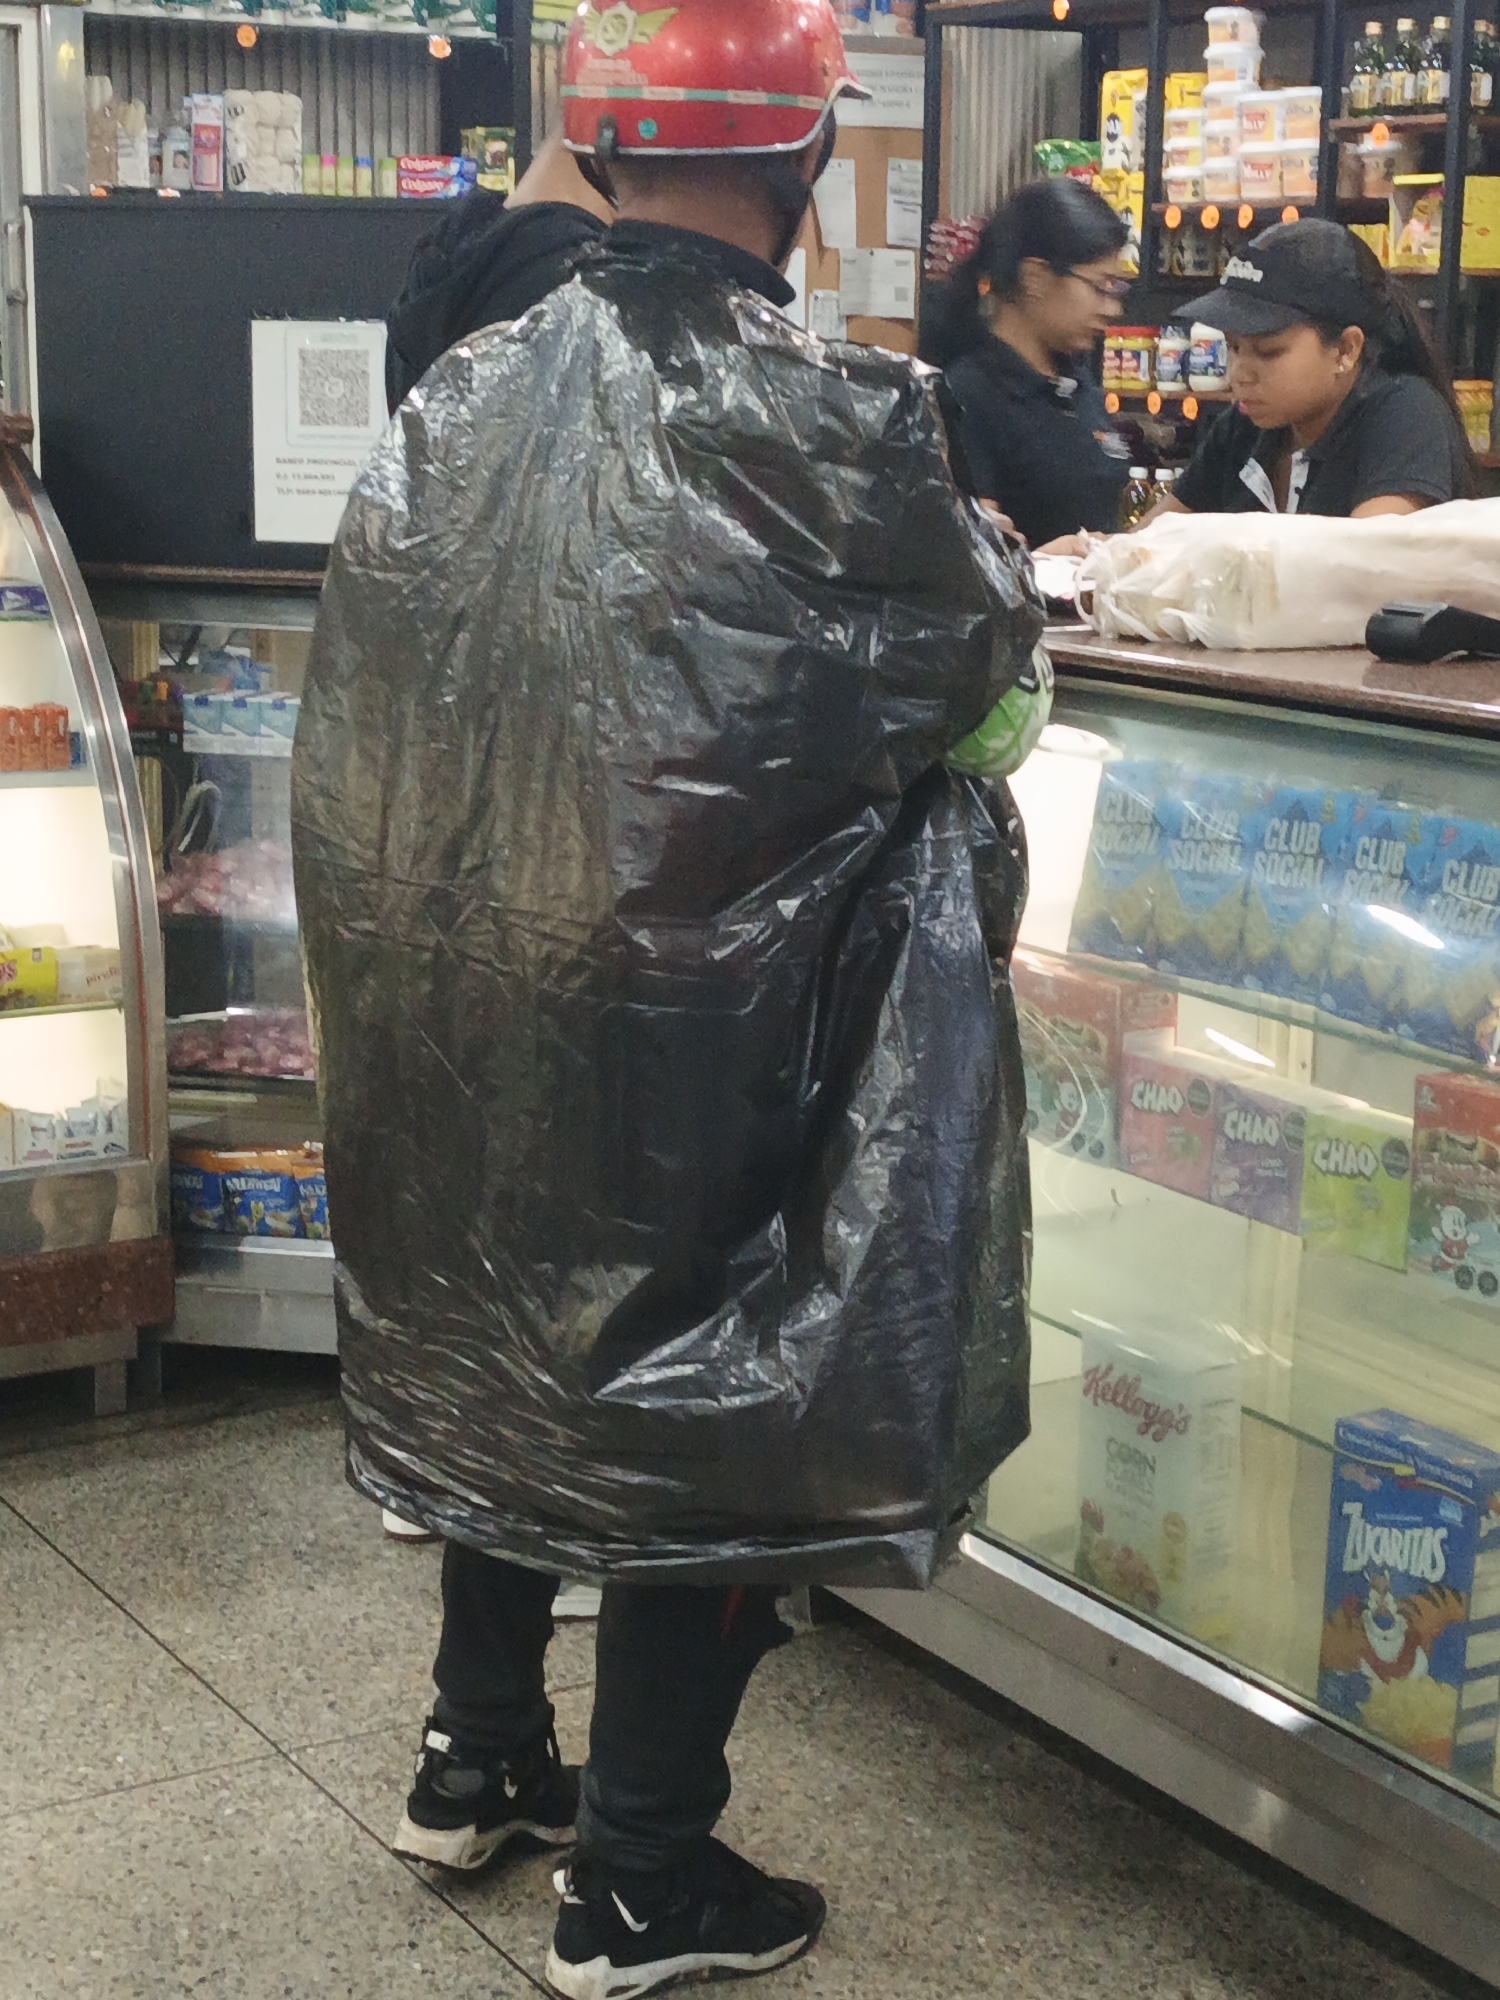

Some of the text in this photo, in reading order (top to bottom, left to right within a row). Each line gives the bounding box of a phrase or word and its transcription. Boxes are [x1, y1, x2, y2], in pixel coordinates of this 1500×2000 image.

[1264, 817, 1322, 855] CLUB
[1355, 836, 1407, 876] CLUB
[1252, 850, 1326, 889] SOCIAL
[1442, 859, 1500, 902] CLUB
[1130, 1079, 1185, 1116] CHAO
[1223, 1108, 1281, 1148] CHAO
[1312, 1138, 1379, 1180] CHAO
[1082, 1363, 1193, 1443] Kellogg's
[1106, 1437, 1157, 1475] CORN
[1341, 1501, 1449, 1583] ZUCARITAS
